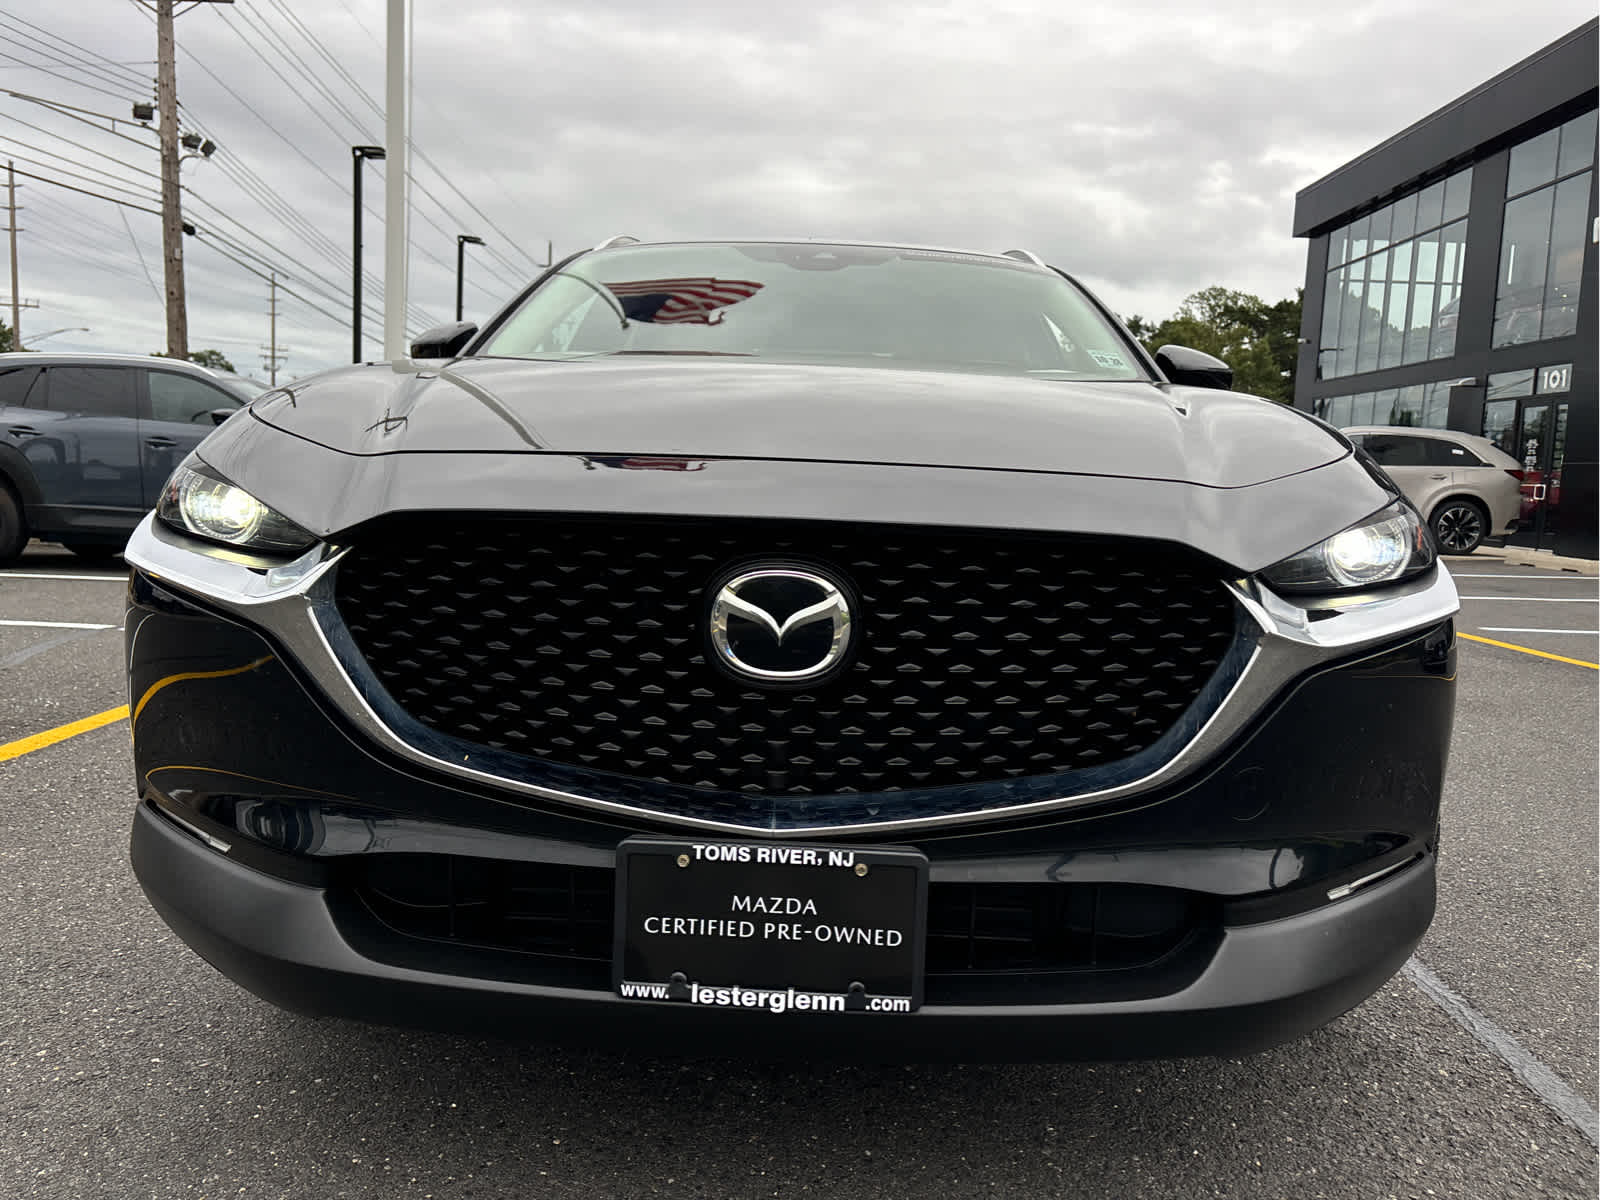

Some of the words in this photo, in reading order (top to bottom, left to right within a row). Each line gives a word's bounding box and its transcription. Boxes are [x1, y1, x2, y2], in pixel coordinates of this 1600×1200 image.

[1543, 369, 1567, 389] 101
[692, 844, 751, 863] TOMS
[757, 847, 823, 866] RIVER,
[828, 850, 855, 868] NJ
[731, 895, 818, 915] MAZDA
[643, 916, 755, 938] CERTIFIED
[764, 923, 903, 947] PRE-OWNED
[620, 983, 670, 1000] www.
[691, 983, 846, 1014] lesterglenn
[865, 996, 911, 1012] .com
